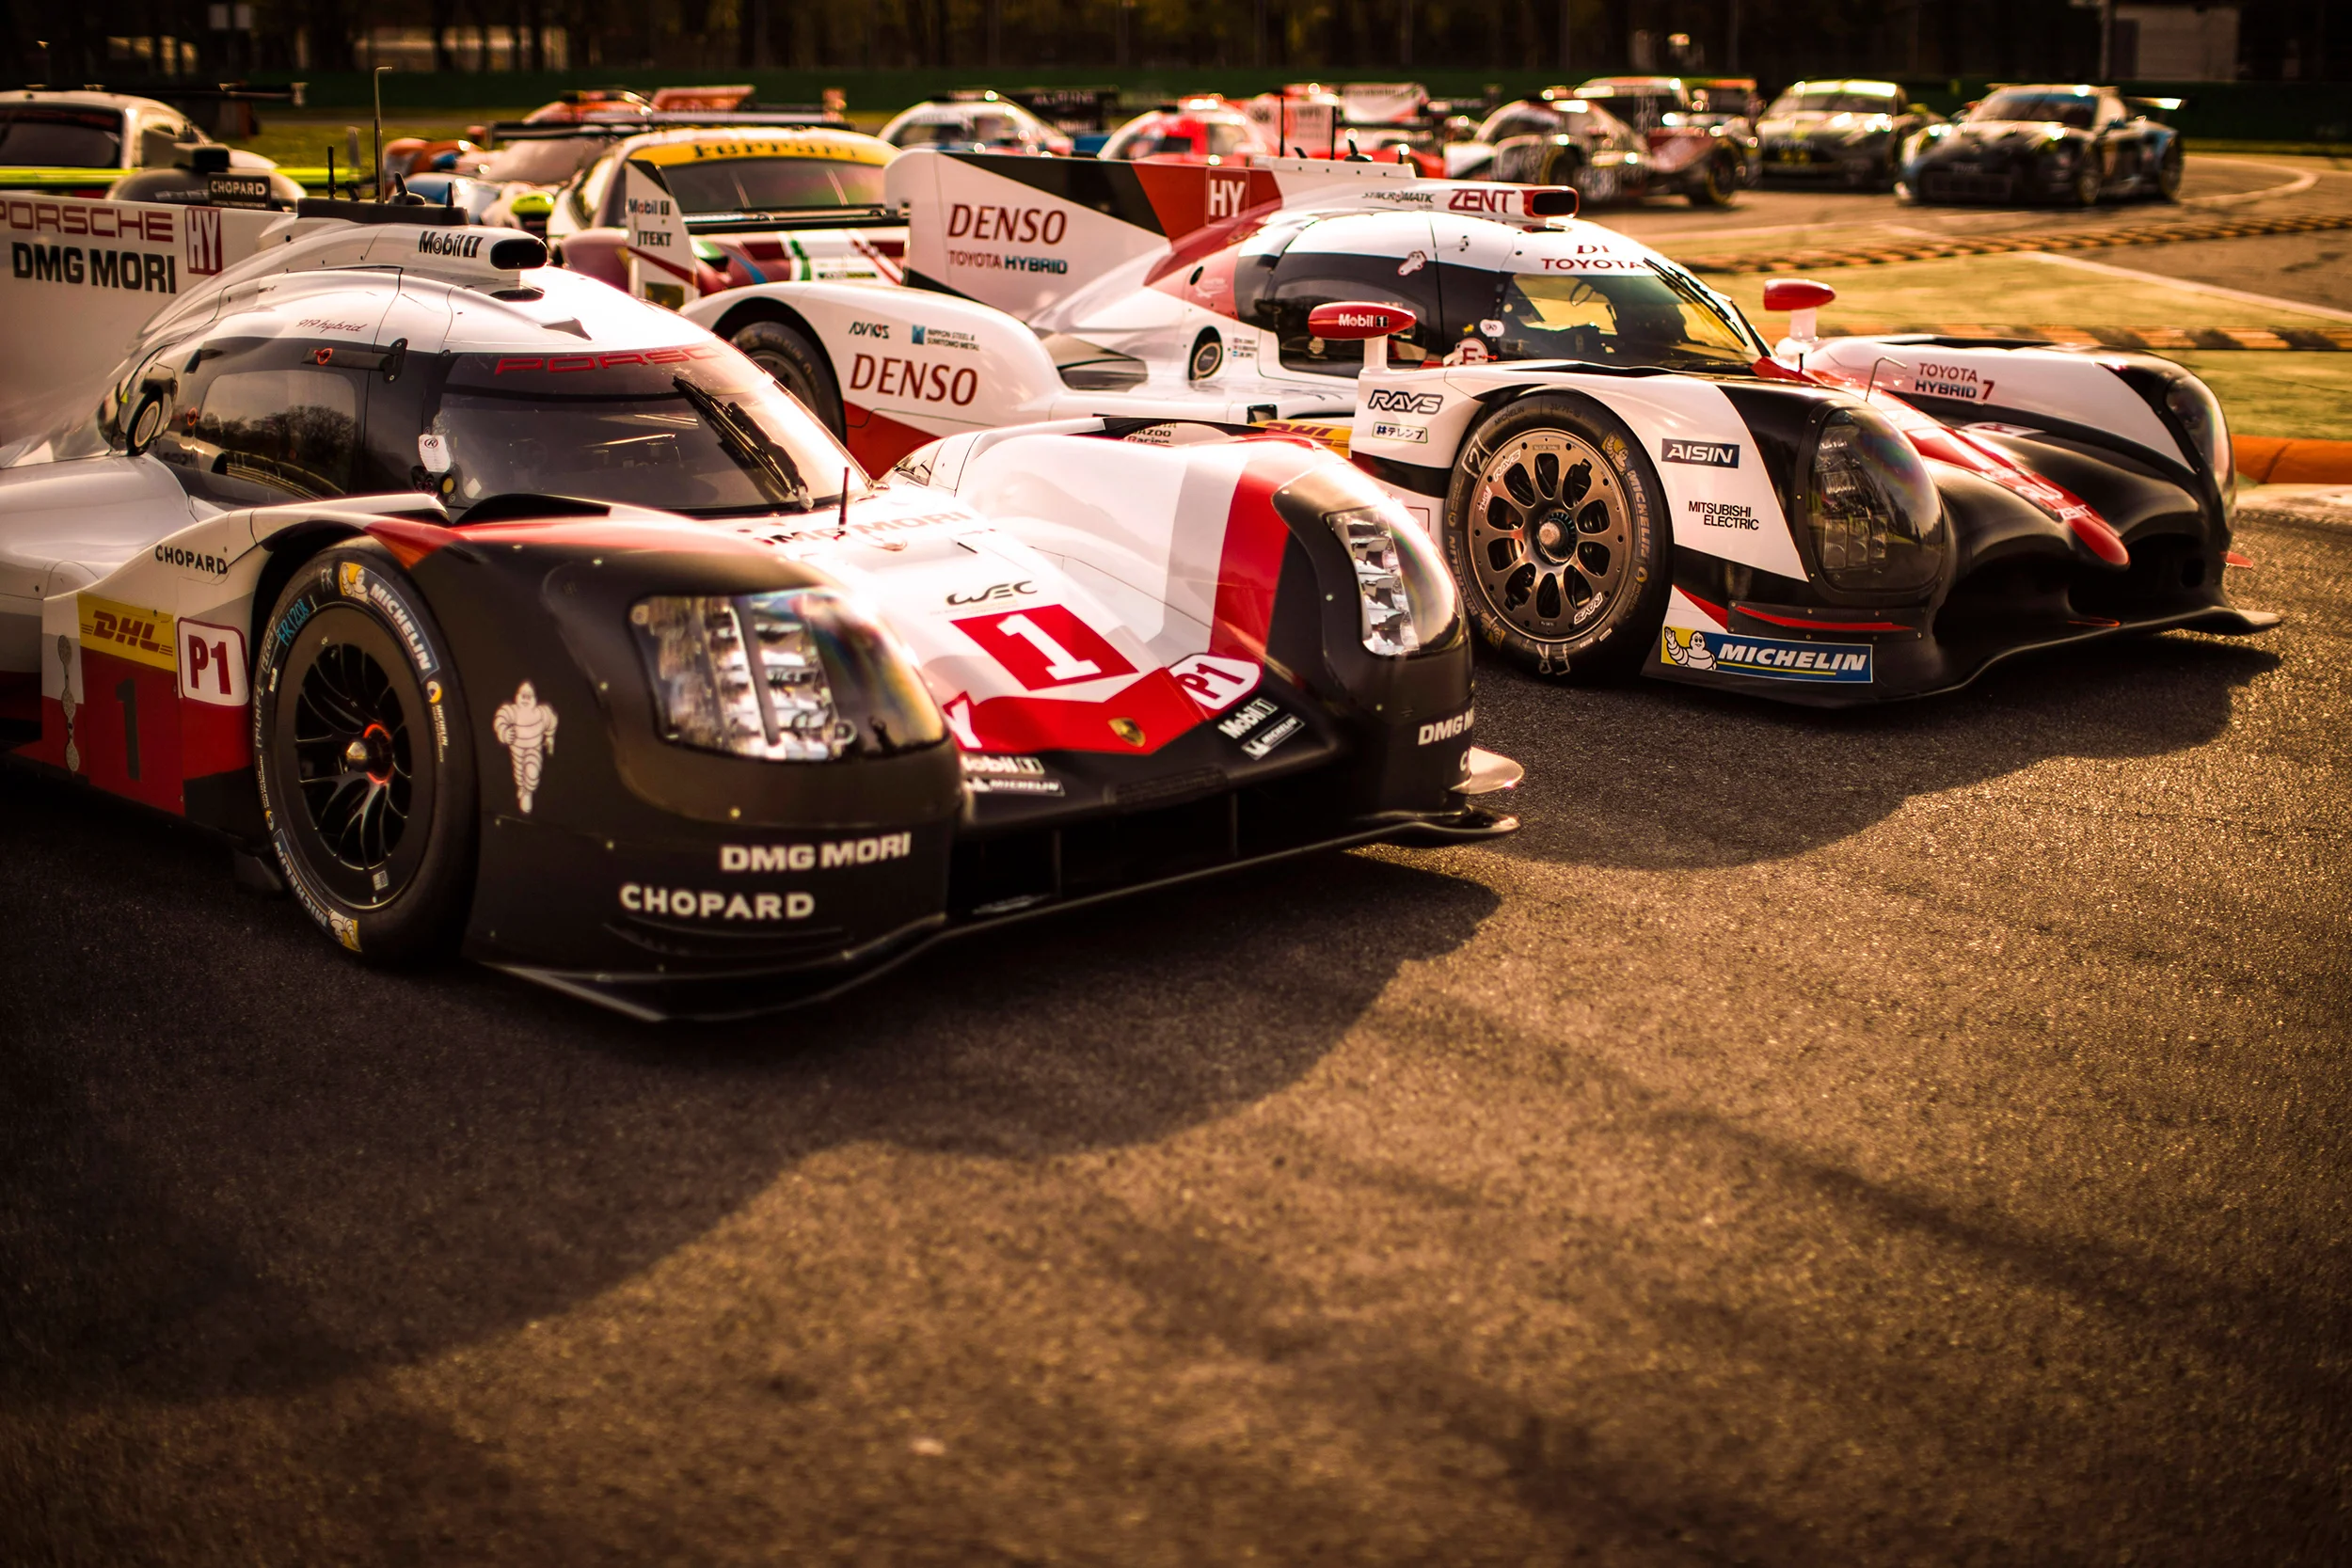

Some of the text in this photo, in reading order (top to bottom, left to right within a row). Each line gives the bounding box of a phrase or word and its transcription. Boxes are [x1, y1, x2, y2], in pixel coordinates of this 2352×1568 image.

[211, 181, 266, 196] CHOPARD
[1209, 180, 1247, 218] HY
[1447, 188, 1517, 214] ZENT
[629, 198, 658, 214] Mobil
[637, 230, 673, 247] JTEKT
[947, 203, 1068, 245] DENSO
[188, 209, 219, 271] HY
[418, 230, 485, 259] Mobil 1
[11, 241, 177, 294] DMG MORI
[948, 250, 1068, 275] TOYOTA HYBRID
[1541, 258, 1647, 271] TOYOTA
[315, 320, 368, 334] hybrid
[1338, 313, 1390, 328] Mobil 1
[952, 330, 970, 341] STEEL
[960, 341, 980, 352] METAL
[850, 353, 979, 406] DENSO
[1918, 362, 1979, 384] TOYOTA
[1367, 388, 1444, 415] RAYS
[1915, 378, 1995, 401] HYBRID 7
[1376, 424, 1425, 440] 林テレンプ
[1492, 448, 1521, 483] RAYS
[1666, 443, 1734, 464] AISIN
[1626, 468, 1651, 560] MICHELIN
[1688, 500, 1752, 518] MITSUBISHI
[1703, 514, 1760, 531] ELECTRIC
[154, 544, 230, 576] CHOPARD
[946, 579, 1039, 607] WEC
[1573, 591, 1604, 626] RAYS
[92, 609, 161, 654] DHL
[370, 582, 433, 671] MICHELIN
[994, 613, 1103, 681] 1
[1718, 642, 1867, 671] MICHELIN
[187, 633, 233, 696] P1
[1174, 662, 1246, 701] P1
[115, 676, 142, 783] 1
[437, 705, 449, 747] MICHELIN
[1217, 705, 1267, 739] Mobil
[1417, 715, 1465, 746] DMG
[989, 780, 1059, 793] MICHELIN
[720, 831, 913, 872] DMG MORI
[619, 882, 816, 920] CHOPARD
